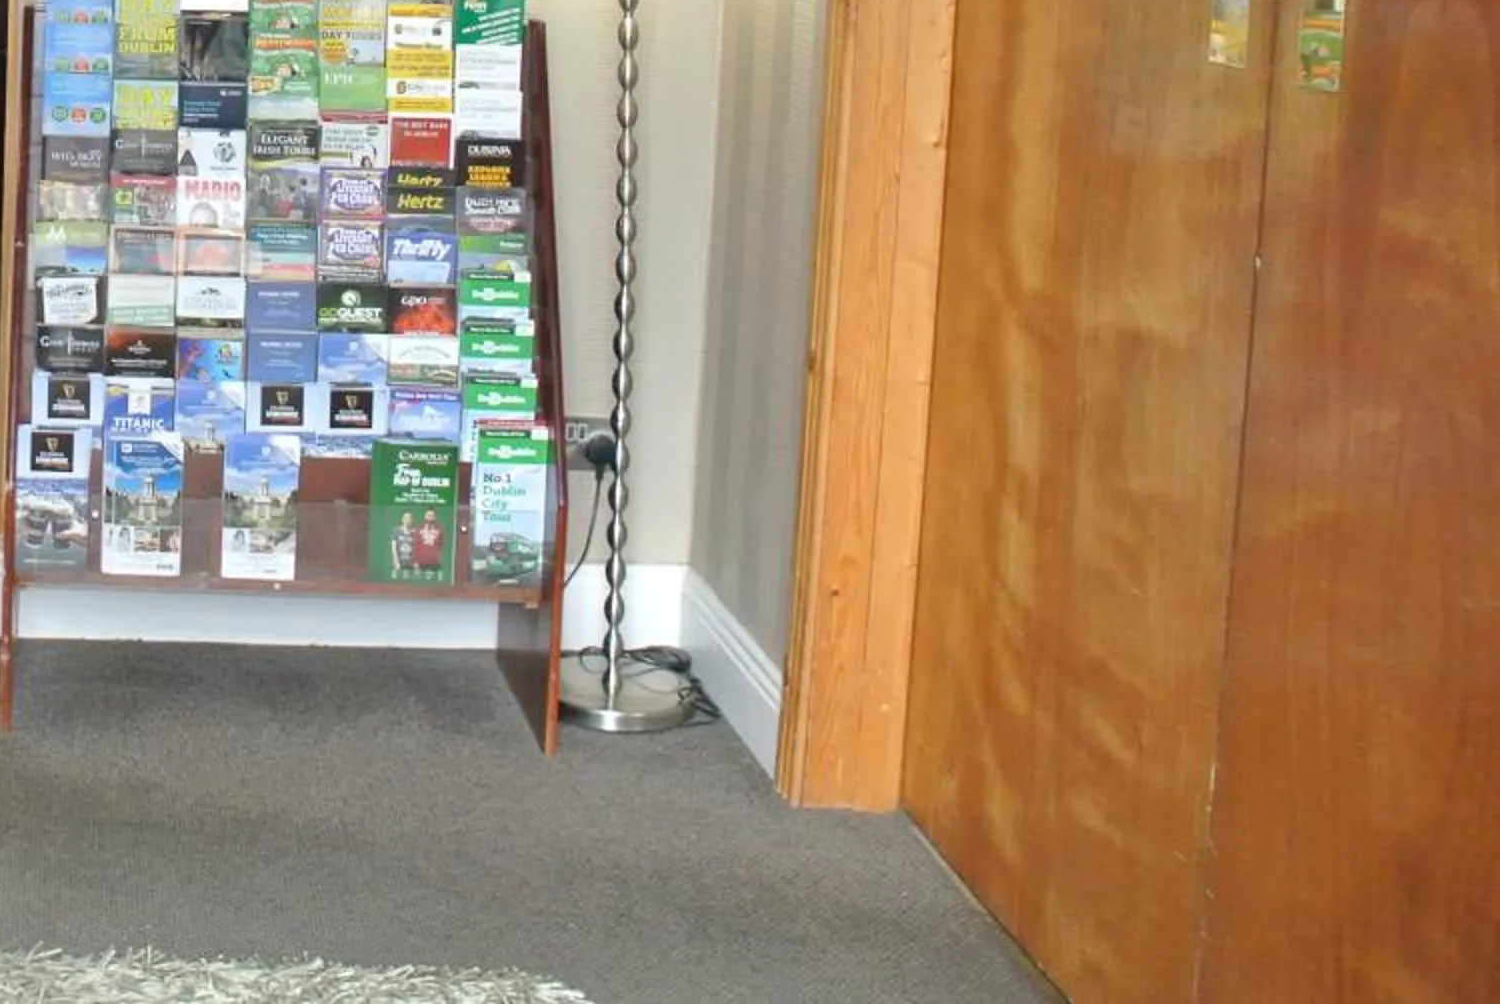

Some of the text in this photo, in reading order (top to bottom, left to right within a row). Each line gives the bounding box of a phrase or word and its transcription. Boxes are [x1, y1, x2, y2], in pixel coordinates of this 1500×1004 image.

[119, 41, 176, 53] DUBLIN
[261, 134, 309, 145] ELEGANT
[253, 145, 281, 155] IRISH
[397, 194, 446, 210] Hertz
[393, 238, 453, 260] Thrifty
[114, 417, 164, 429] TITANIC
[483, 485, 527, 496] Dublin
[482, 497, 508, 512] City
